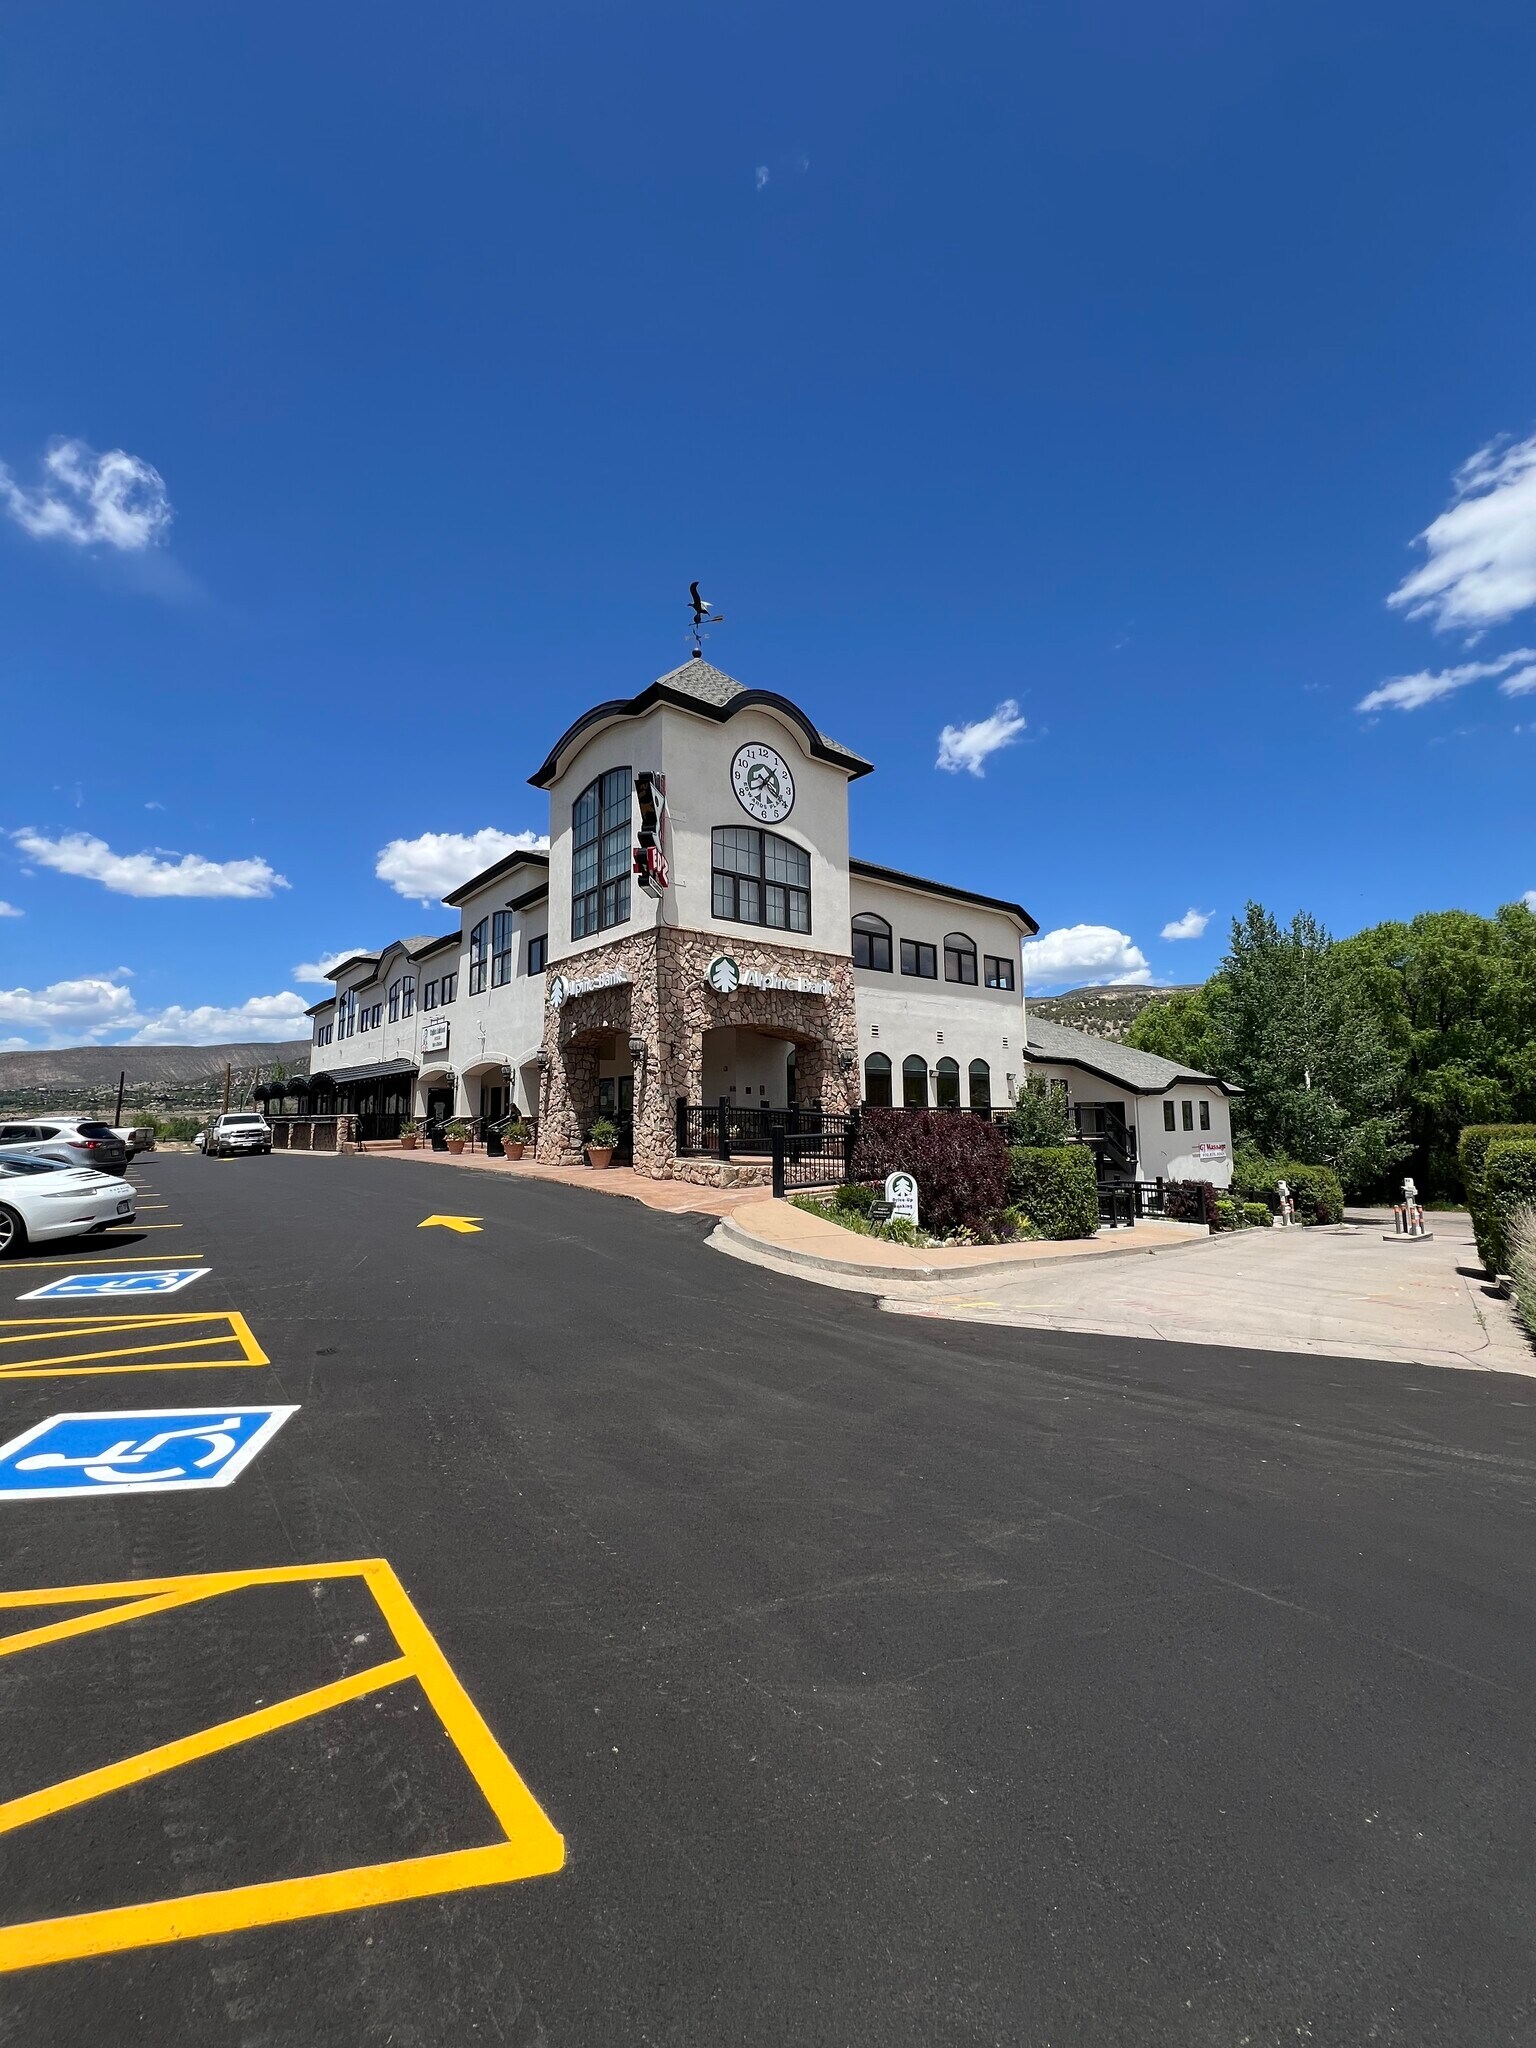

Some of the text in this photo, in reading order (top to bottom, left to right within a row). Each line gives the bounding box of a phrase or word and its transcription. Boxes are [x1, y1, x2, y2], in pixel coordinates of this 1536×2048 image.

[746, 750, 756, 760] 11
[758, 748, 769, 758] 12
[738, 758, 748, 768] 10
[774, 758, 778, 766] 1
[734, 771, 740, 780] 9
[782, 771, 788, 780] 2
[738, 788, 745, 796] 8
[786, 786, 792, 796] 3
[750, 803, 755, 812] 7
[782, 800, 788, 809] 4
[761, 810, 767, 818] 6
[774, 810, 779, 818] 5
[599, 967, 624, 988] Bank
[745, 969, 834, 996] Alpine Bank
